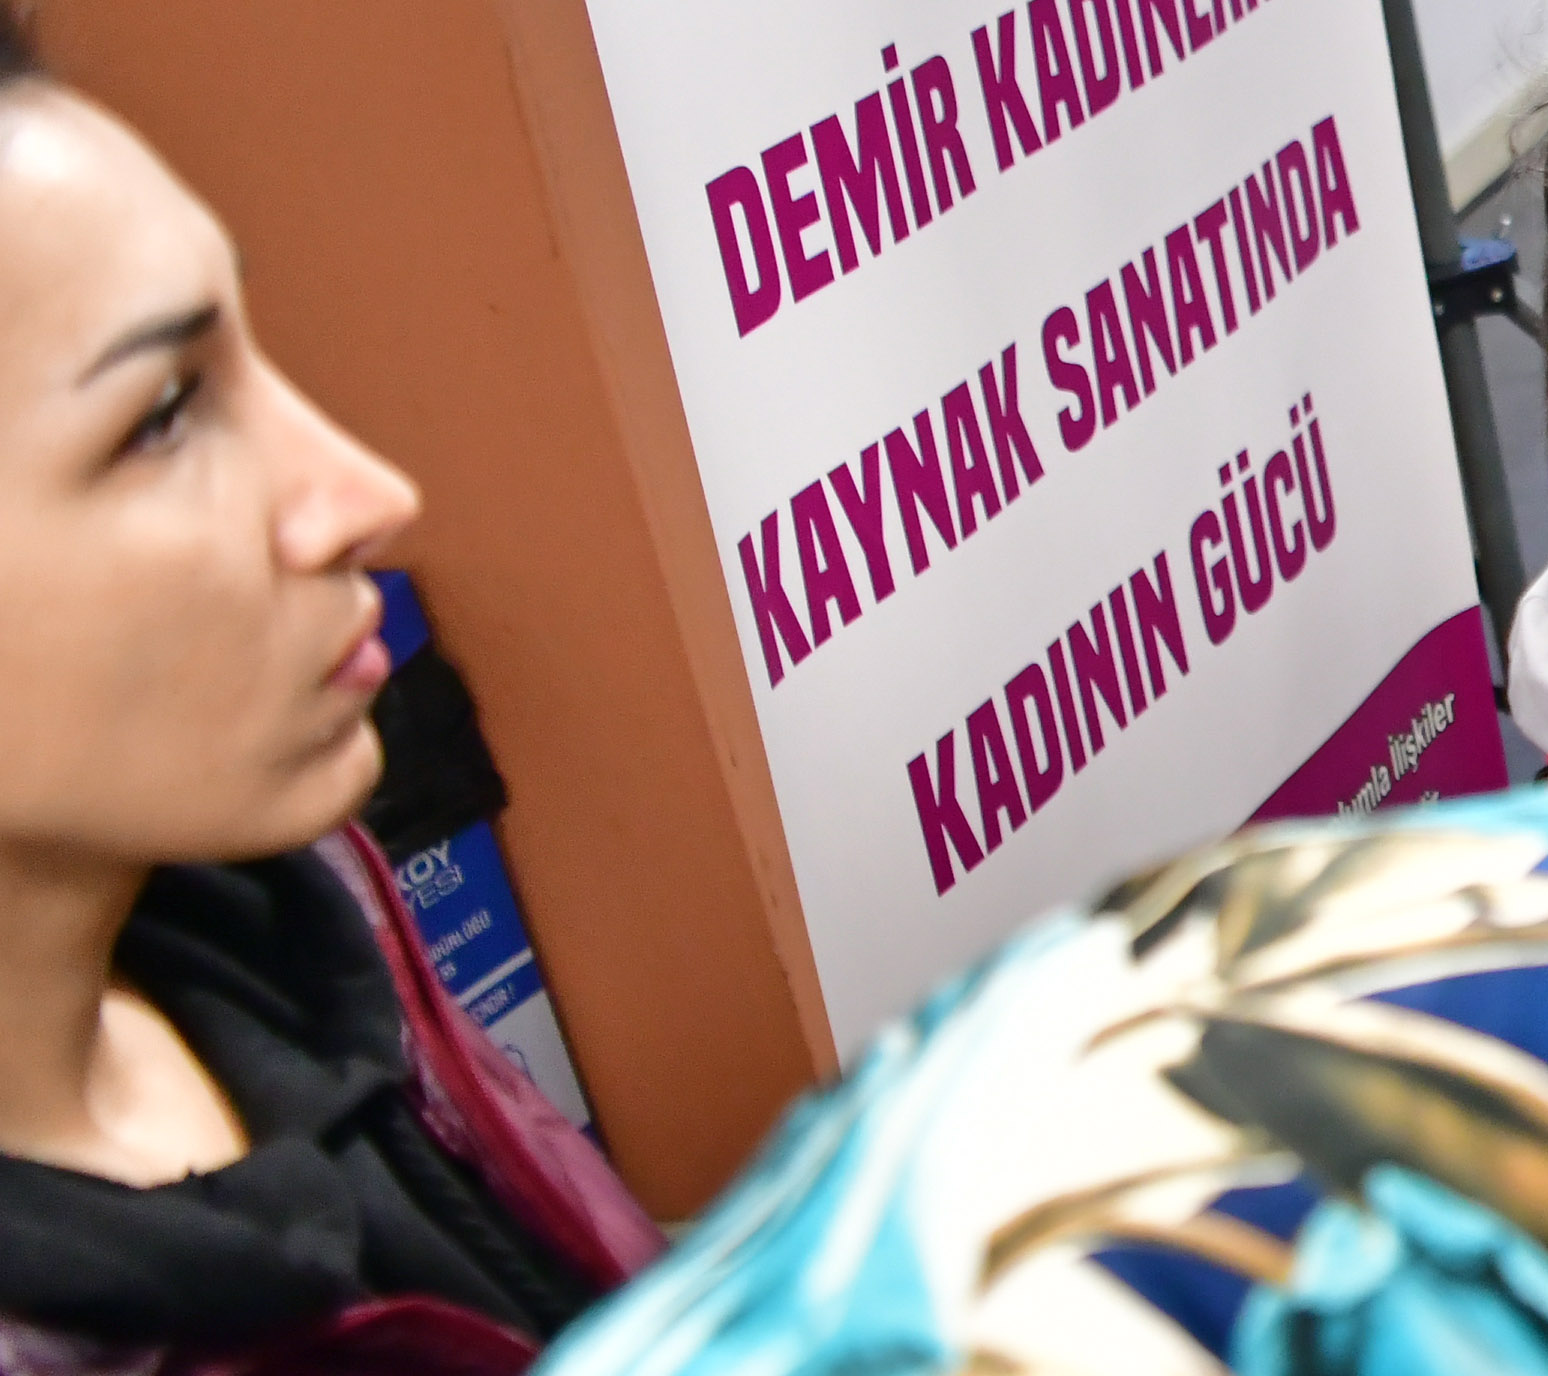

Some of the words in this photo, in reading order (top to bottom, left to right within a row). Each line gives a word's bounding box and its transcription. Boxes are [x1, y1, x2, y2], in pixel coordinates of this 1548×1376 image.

[704, 41, 977, 338] DEMİR
[736, 343, 1046, 690] KAYNAK
[1040, 113, 1361, 454] SANATINDA
[905, 548, 1191, 898] KADININ
[1186, 391, 1338, 647] GÜCÜ
